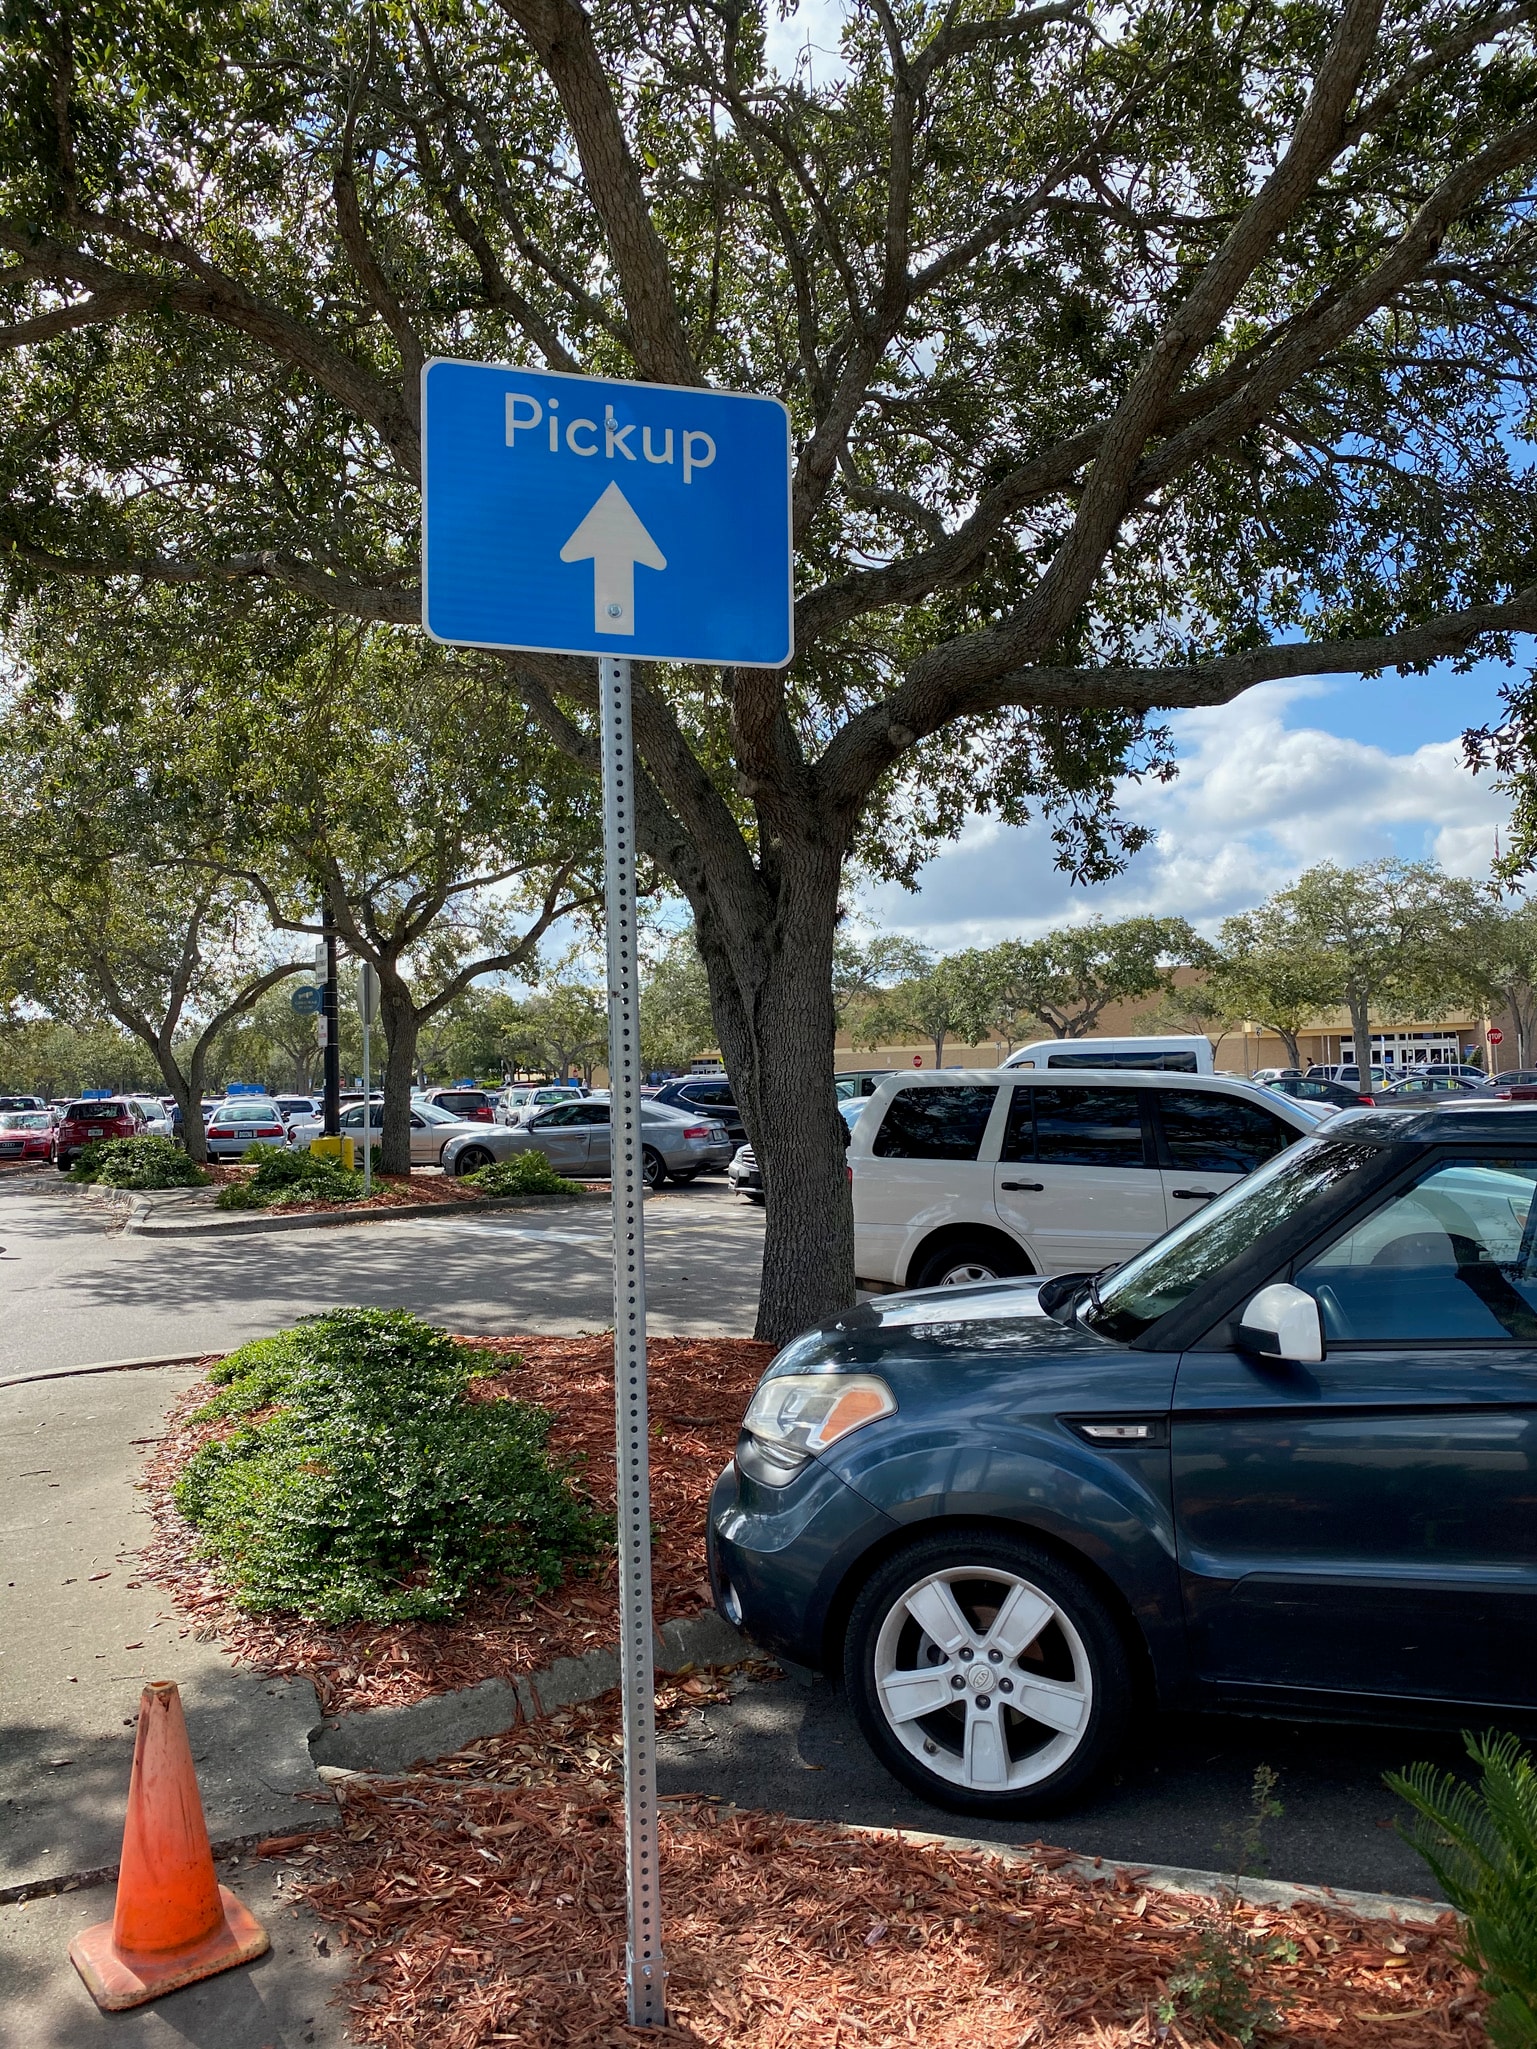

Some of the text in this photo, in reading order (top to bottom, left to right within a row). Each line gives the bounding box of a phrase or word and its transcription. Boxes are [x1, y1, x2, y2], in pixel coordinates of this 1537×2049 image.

[504, 391, 717, 485] Pickup
[1487, 1032, 1502, 1040] STOP
[975, 1672, 987, 1686] KIA
